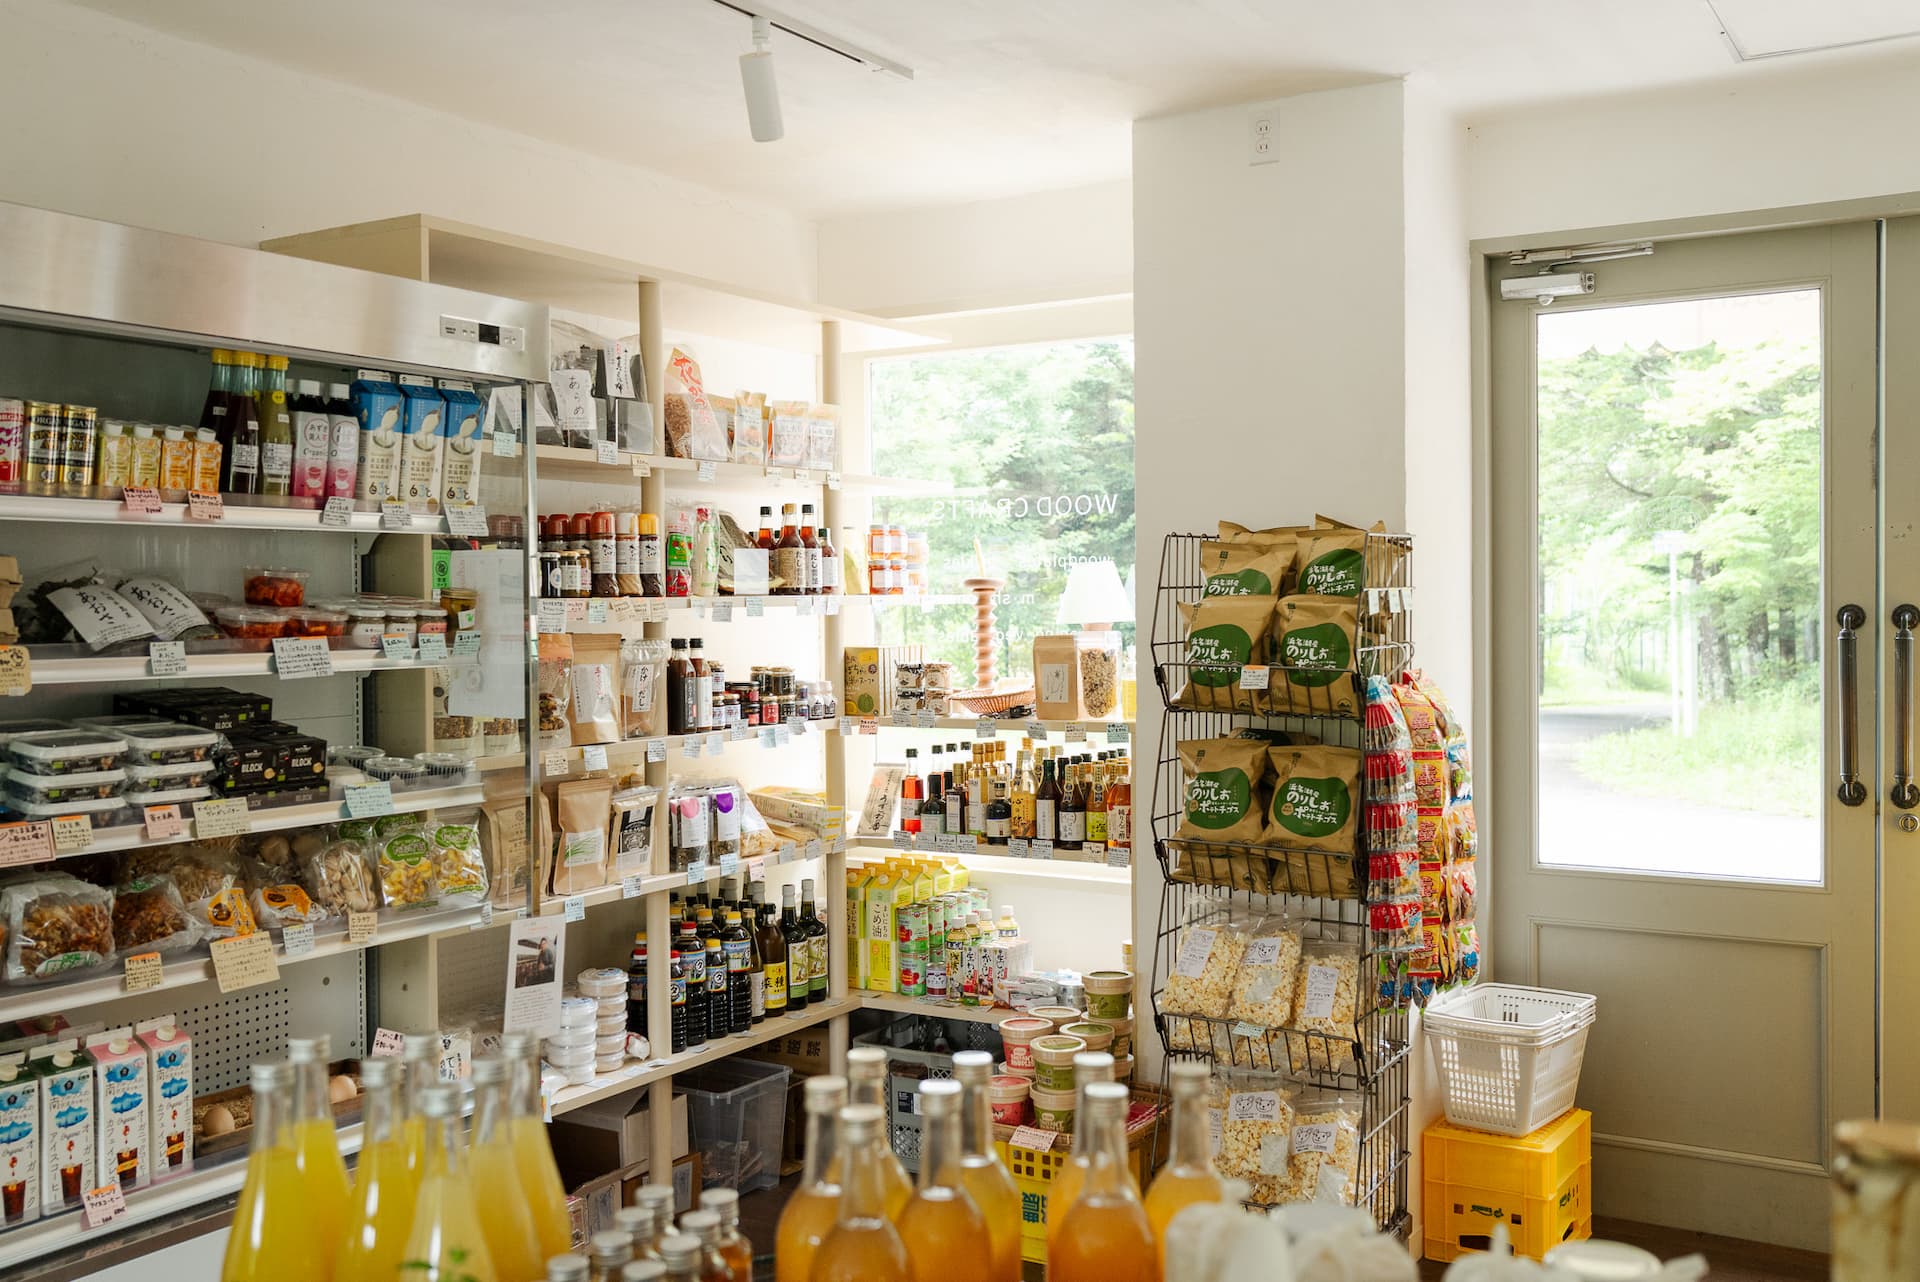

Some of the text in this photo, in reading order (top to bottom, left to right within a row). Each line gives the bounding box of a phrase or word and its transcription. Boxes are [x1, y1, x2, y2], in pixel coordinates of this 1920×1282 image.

[1306, 570, 1348, 586] のりしお
[1286, 645, 1329, 661] のりしお
[241, 763, 264, 774] BLOCK
[291, 757, 313, 768] BLOCK
[1191, 787, 1232, 801] のりしお
[1286, 790, 1332, 812] のりしお
[872, 903, 882, 938] こめ油
